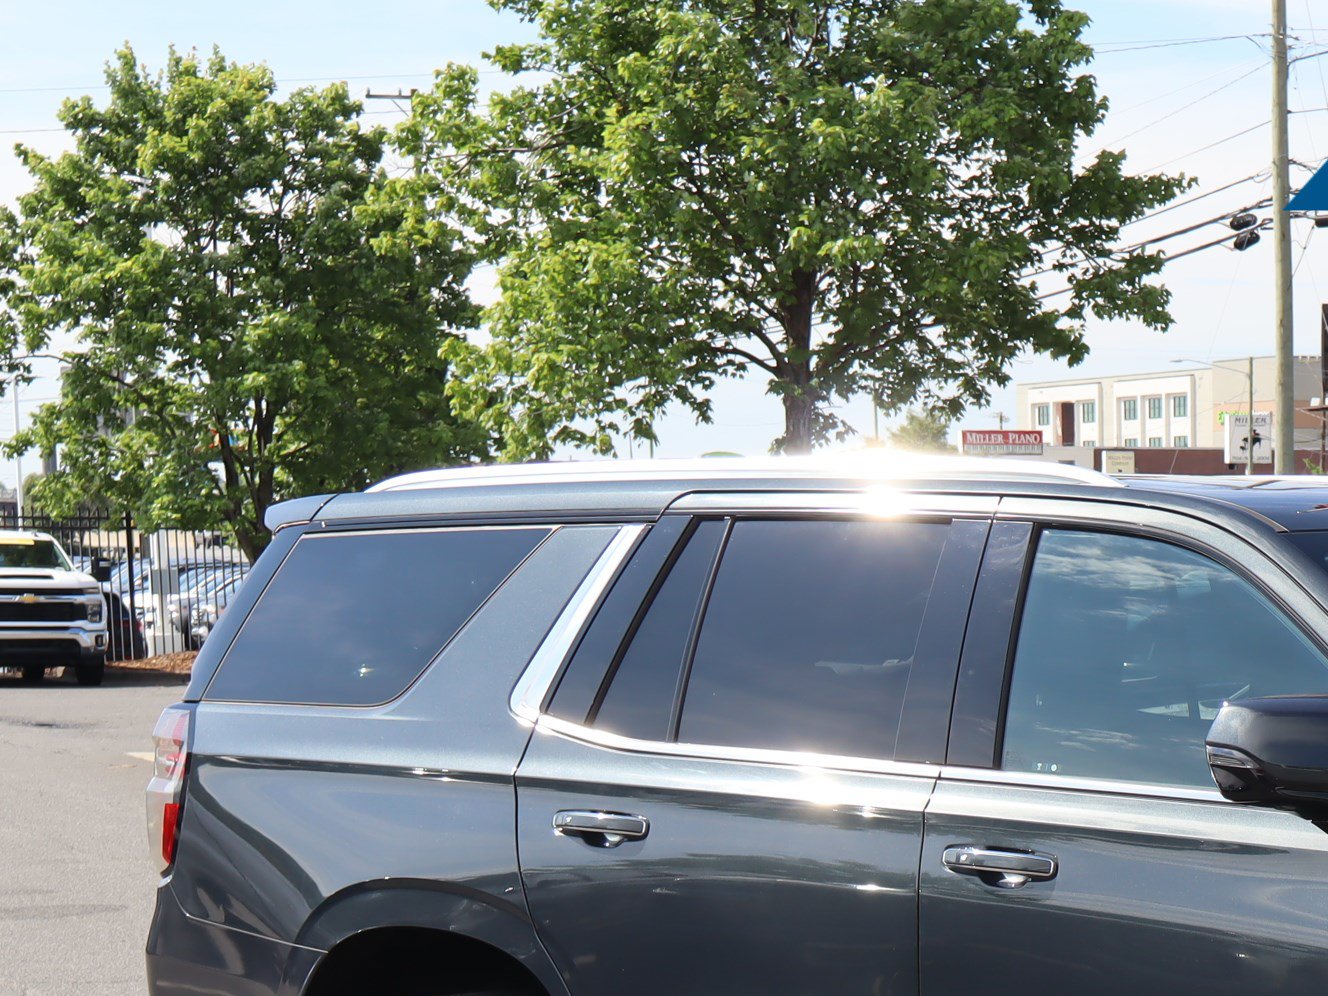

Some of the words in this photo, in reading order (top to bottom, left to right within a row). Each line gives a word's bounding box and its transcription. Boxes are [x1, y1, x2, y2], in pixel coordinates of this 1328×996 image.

[1234, 416, 1267, 424] MILER
[966, 432, 1004, 444] MILLER
[1008, 432, 1040, 444] PIANO
